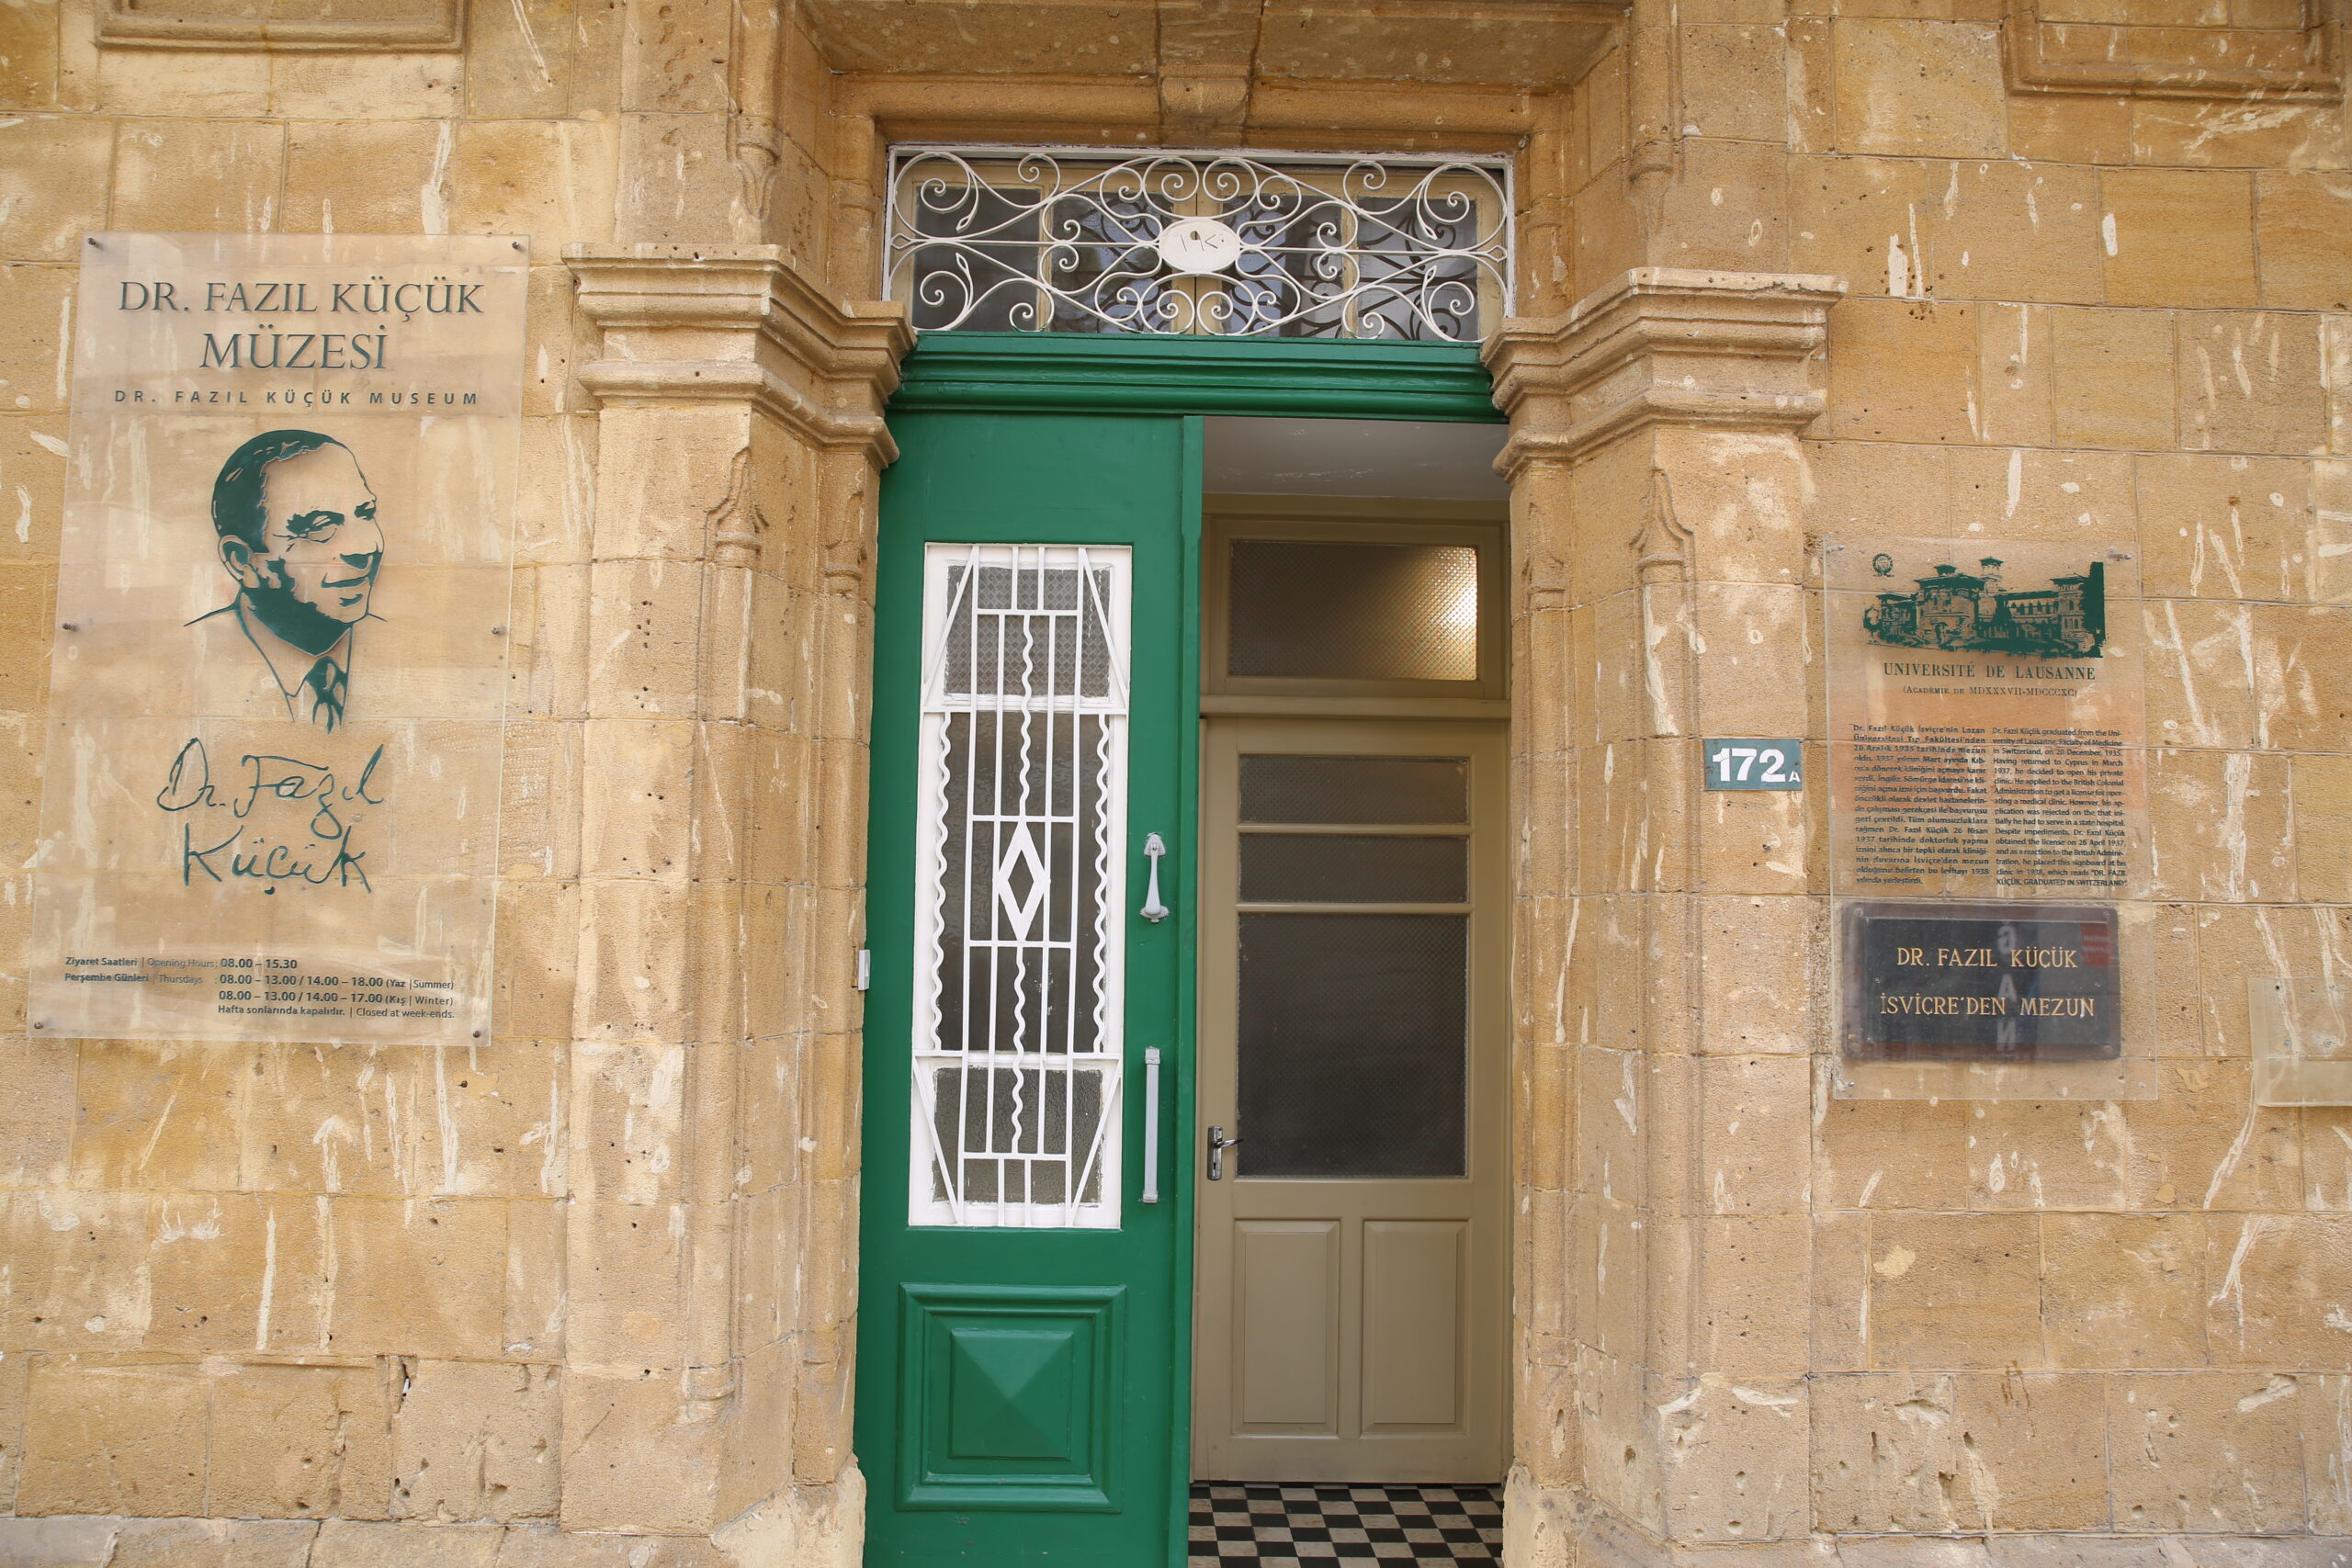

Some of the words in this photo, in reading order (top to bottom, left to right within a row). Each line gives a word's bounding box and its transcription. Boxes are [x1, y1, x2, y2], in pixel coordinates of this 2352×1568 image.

[118, 281, 190, 311] DR.
[204, 282, 318, 312] FAZIL
[331, 276, 485, 322] KÜÇÜK
[199, 323, 389, 369] MÜZESİ
[115, 390, 155, 402] DR.
[175, 390, 247, 403] FAZIL
[266, 389, 351, 407] KÜÇÜK
[369, 392, 477, 404] MUSEUM
[1883, 661, 1975, 677] UNIVERSITÉ
[1986, 665, 2005, 678] DE
[2016, 666, 2096, 680] LAUSANNE
[157, 737, 226, 812] Dr.
[65, 956, 99, 966] Ziyaret
[101, 956, 138, 965] Saatleri
[147, 957, 185, 969] Opening
[220, 958, 254, 968] 08.00
[265, 959, 298, 969] 15.30
[1896, 947, 1930, 965] DR.
[1937, 948, 1997, 966] FAZIL
[2010, 945, 2078, 969] KÜÇÜK
[64, 973, 112, 983] Perşembe
[114, 973, 149, 982] Günleri
[159, 975, 203, 986] Thursdays
[220, 975, 252, 985] 08.00
[265, 976, 297, 986] 13.00
[307, 976, 339, 986] 14.00
[351, 976, 383, 987] 18.00
[219, 990, 252, 1000] 08.00
[264, 991, 296, 1001] 13.00
[306, 992, 338, 1002] 14.00
[350, 993, 382, 1003] 17.00
[385, 996, 405, 1006] (Kış
[415, 997, 453, 1006] Winter)
[218, 1005, 244, 1014] Hafta
[246, 1006, 298, 1015] sonlarında
[300, 1007, 345, 1017] kapalıdır.
[356, 1008, 388, 1017] Closed
[402, 1010, 455, 1019] week-ends.
[2020, 998, 2096, 1018] MEZUN
